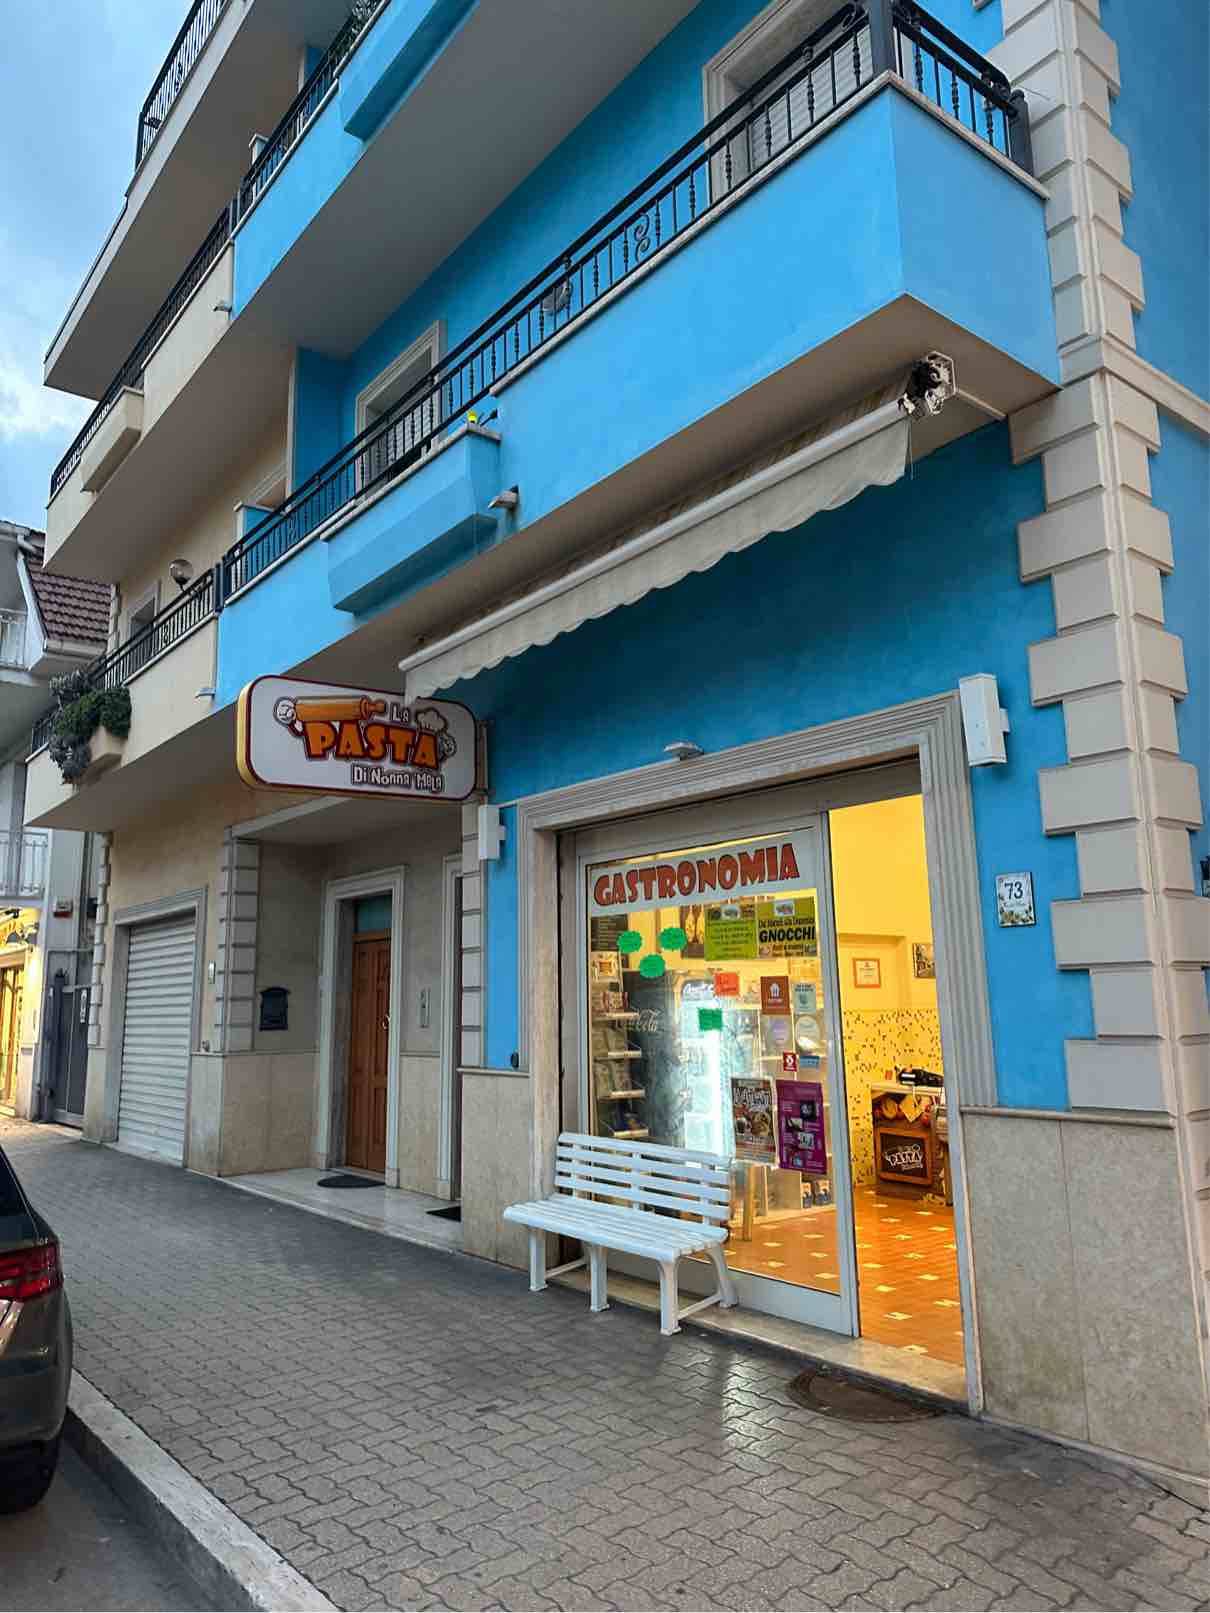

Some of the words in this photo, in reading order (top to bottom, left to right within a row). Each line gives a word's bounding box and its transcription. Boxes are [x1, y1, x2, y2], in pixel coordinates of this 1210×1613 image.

[303, 719, 440, 769] PASTA
[352, 765, 367, 783] Di
[593, 843, 801, 906] GASTRONOMIA
[1004, 881, 1023, 900] 73
[758, 926, 816, 943] GNOCCHI
